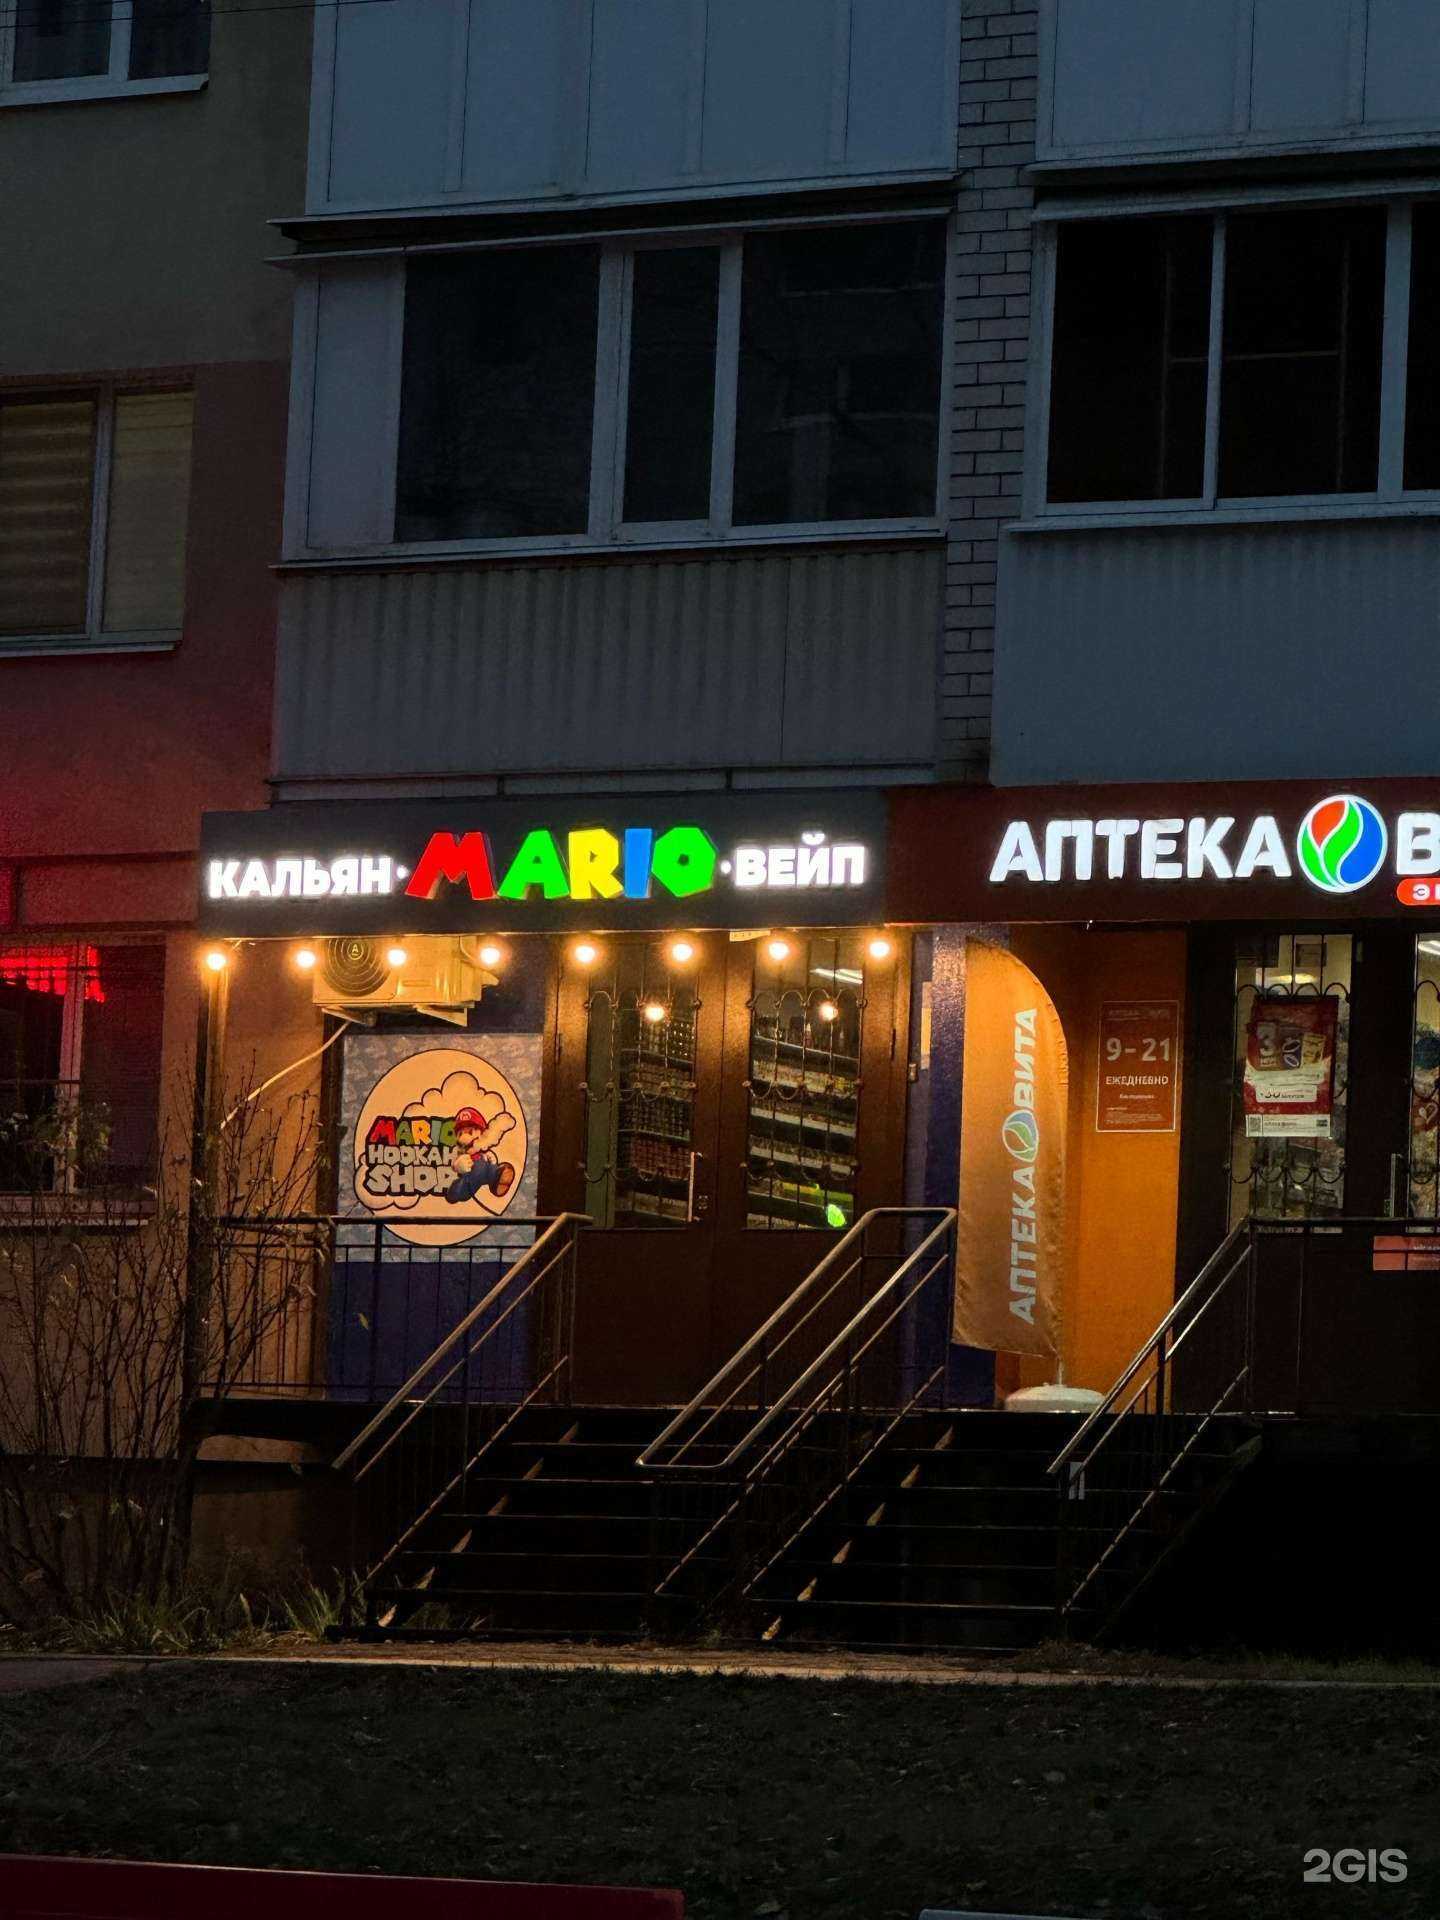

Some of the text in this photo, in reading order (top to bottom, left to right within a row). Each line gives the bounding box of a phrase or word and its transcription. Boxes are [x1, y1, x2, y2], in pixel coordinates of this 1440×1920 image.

[207, 827, 867, 900] КАЛЬЯН MARIO ВЕЙП
[989, 816, 1292, 881] АПТЕКА
[1014, 1008, 1037, 1109] ВИТА
[1105, 1075, 1169, 1086] ЕЖЕДНЕВНО
[367, 1144, 459, 1166] HOOKAH
[368, 1118, 457, 1145] MARIO
[366, 1164, 458, 1193] SHOP
[1009, 1166, 1037, 1325] АПТЕКА
